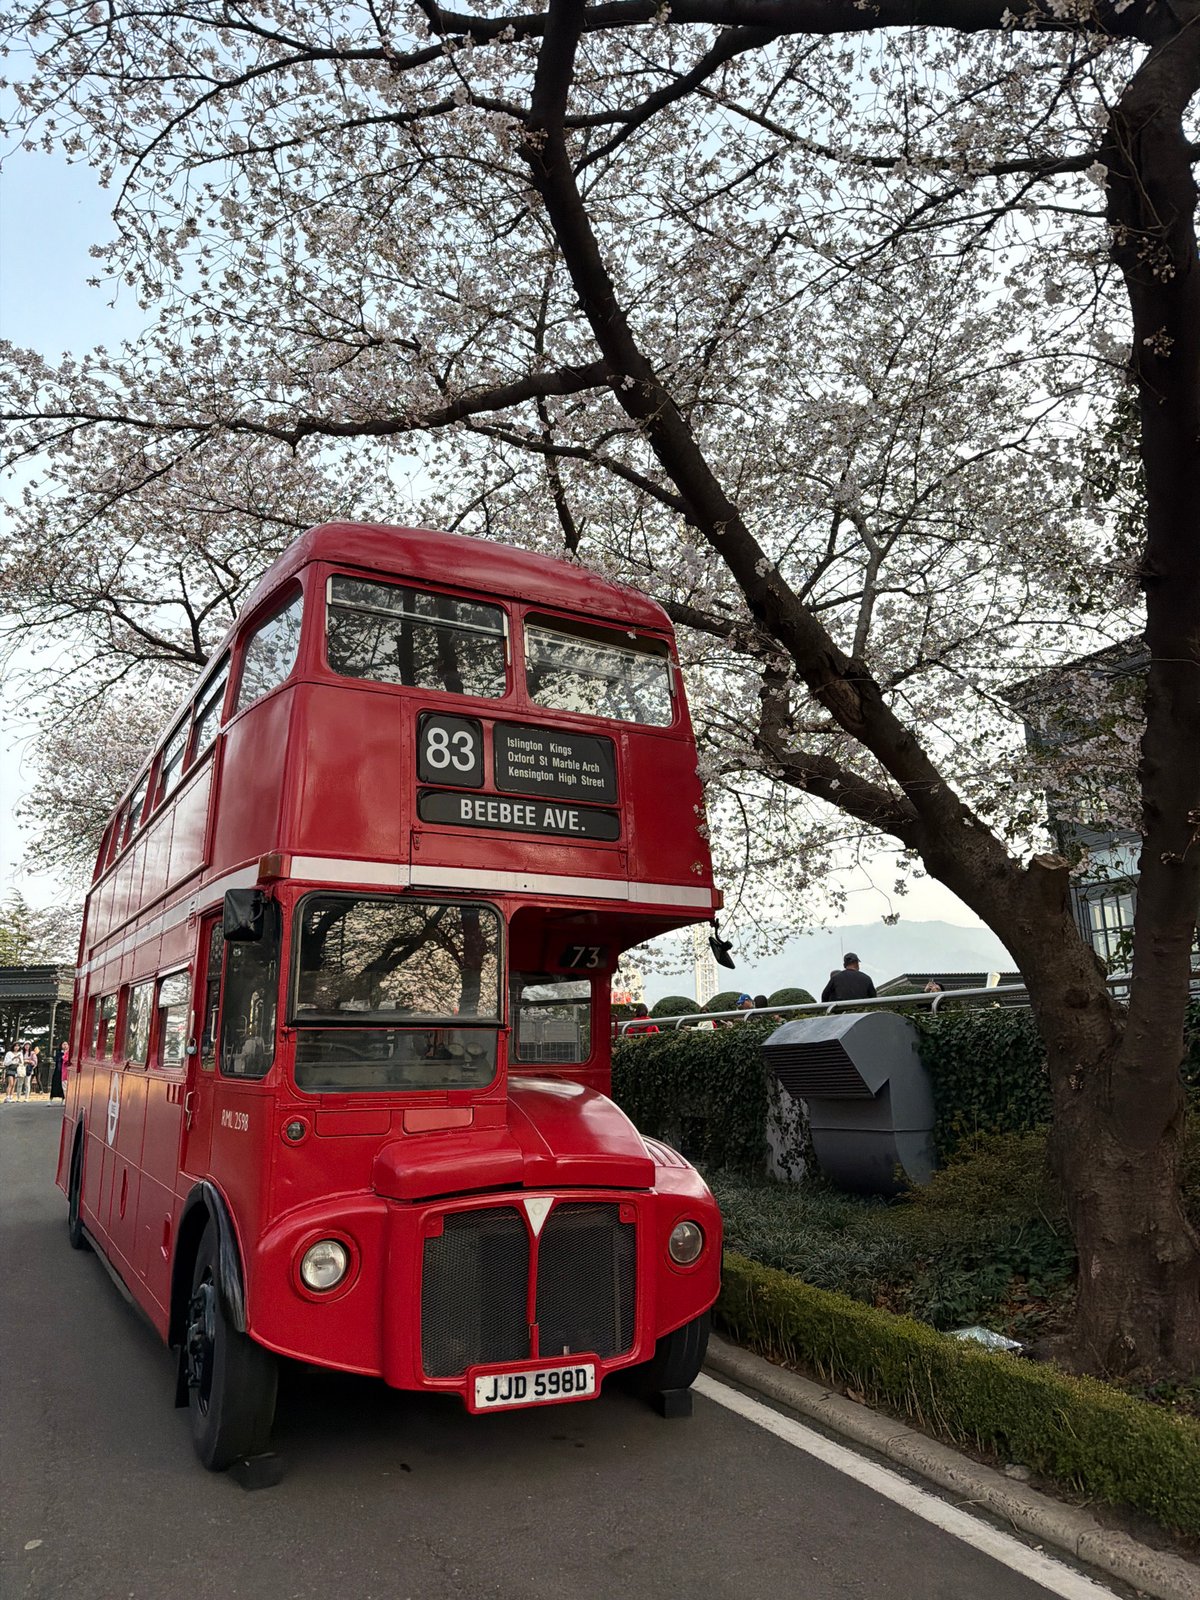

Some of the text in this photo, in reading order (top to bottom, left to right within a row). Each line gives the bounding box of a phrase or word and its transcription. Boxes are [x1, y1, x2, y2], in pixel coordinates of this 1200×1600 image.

[426, 727, 476, 772] 83
[507, 737, 572, 756] Islington Kings
[508, 752, 600, 773] Oxford St Marble Arch
[508, 766, 605, 788] Kensington High Street
[460, 799, 586, 831] BEEBEE AVE.
[570, 947, 600, 968] 73
[234, 1112, 249, 1131] 2598
[485, 1368, 587, 1402] JJD 598D
